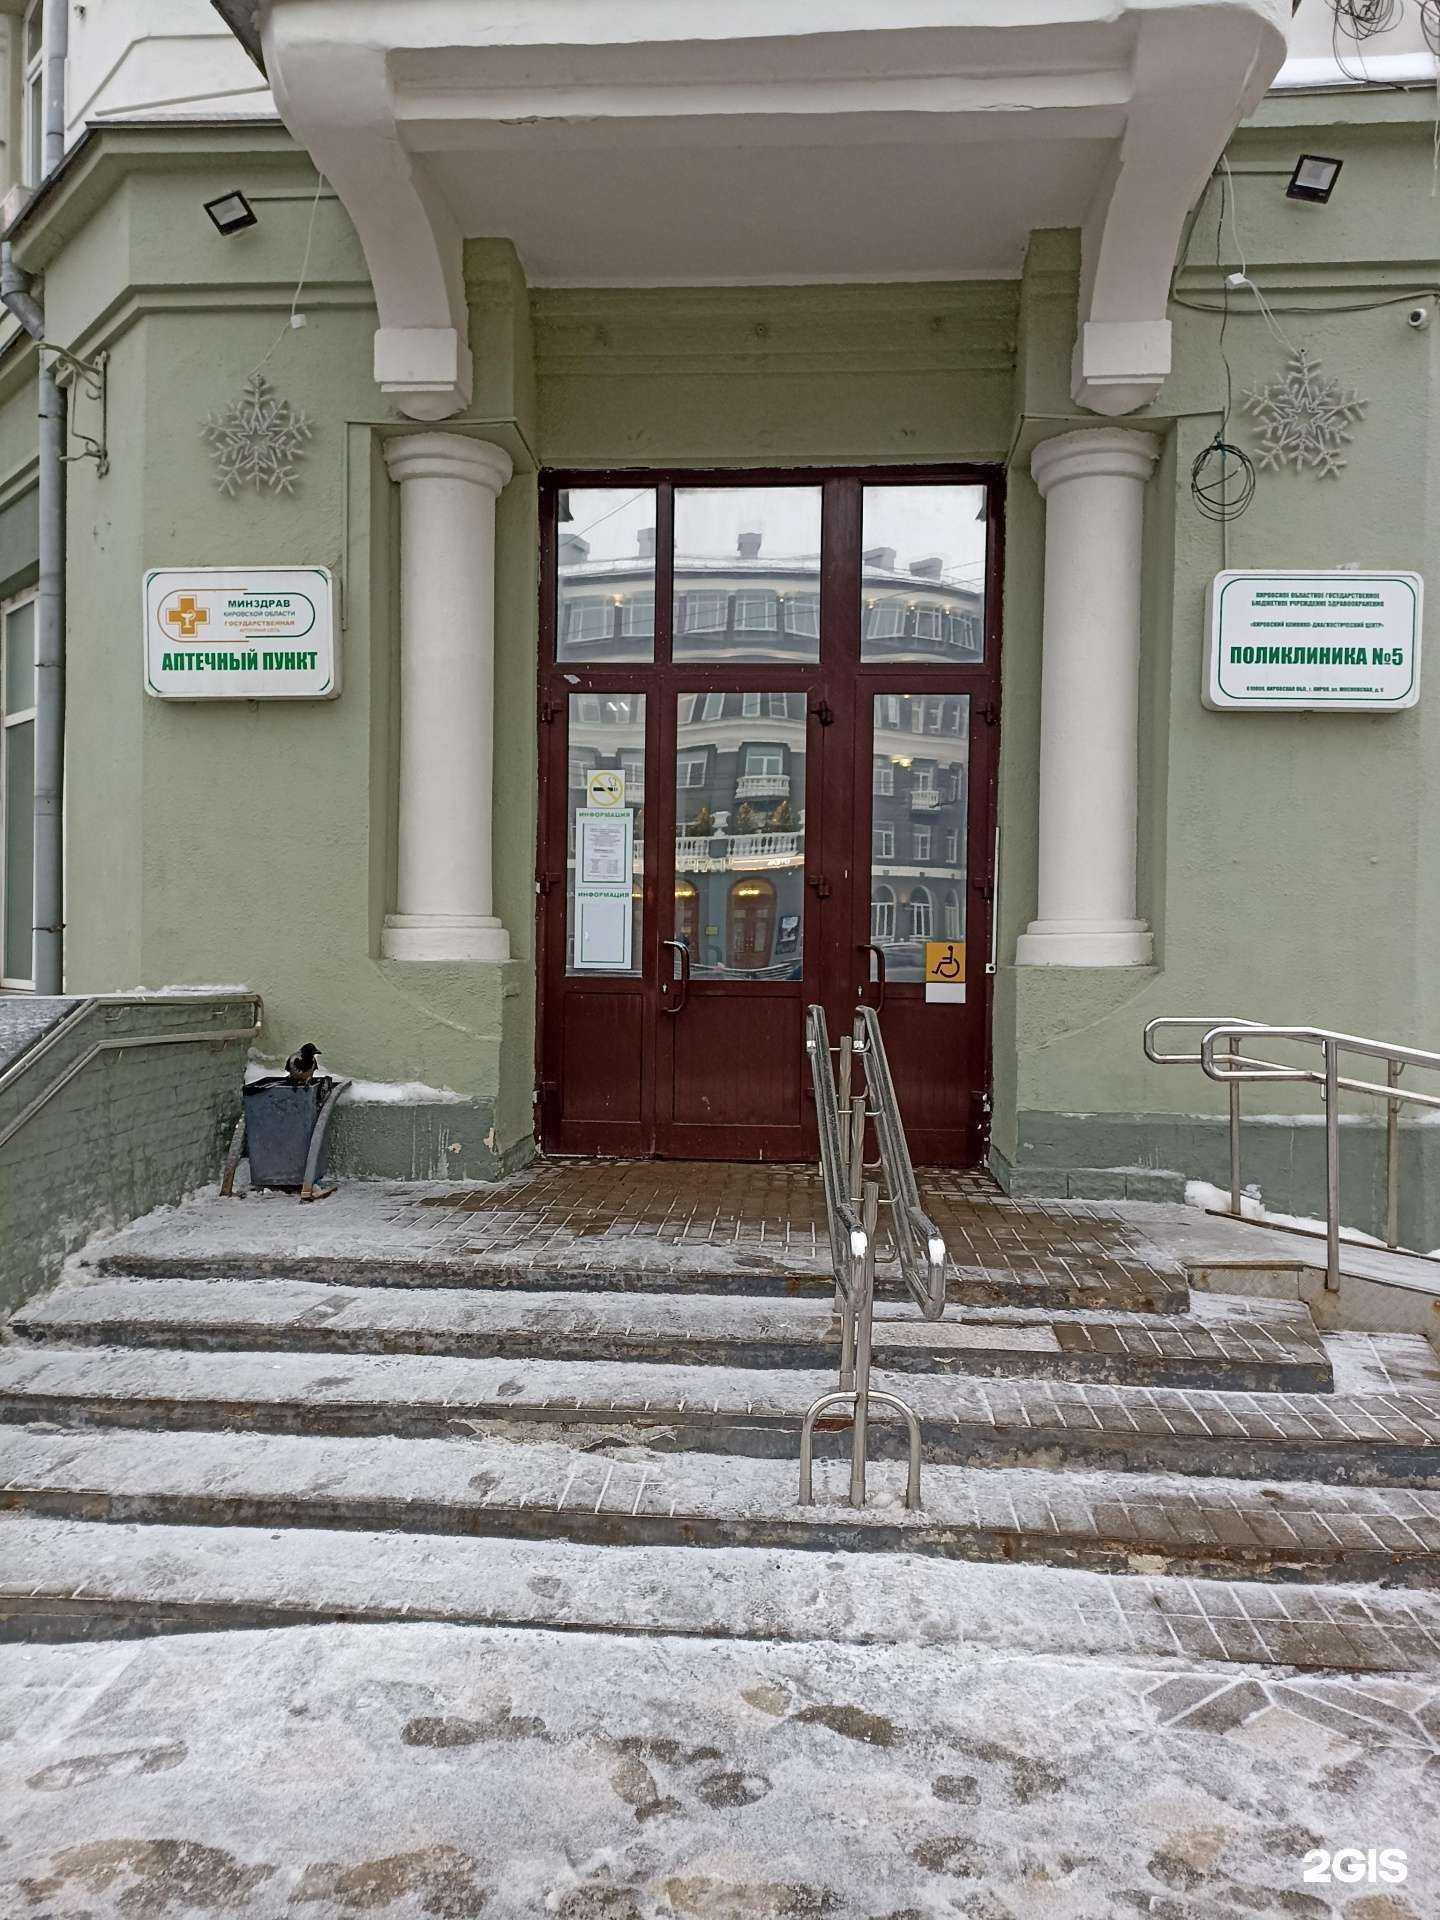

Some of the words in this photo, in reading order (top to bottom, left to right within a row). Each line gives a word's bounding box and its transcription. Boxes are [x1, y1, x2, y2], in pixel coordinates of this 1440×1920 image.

[227, 599, 291, 609] МИНЗДРАВ
[161, 648, 259, 671] АПТЕЧНЫЙ
[262, 651, 318, 671] ПУНКТ
[1230, 646, 1368, 665] ПОЛИКЛИНИКА
[1372, 647, 1404, 666] №5
[578, 811, 631, 819] ИНФОРМАЦИЯ
[577, 891, 630, 899] ИНФОРМАЦИЯ
